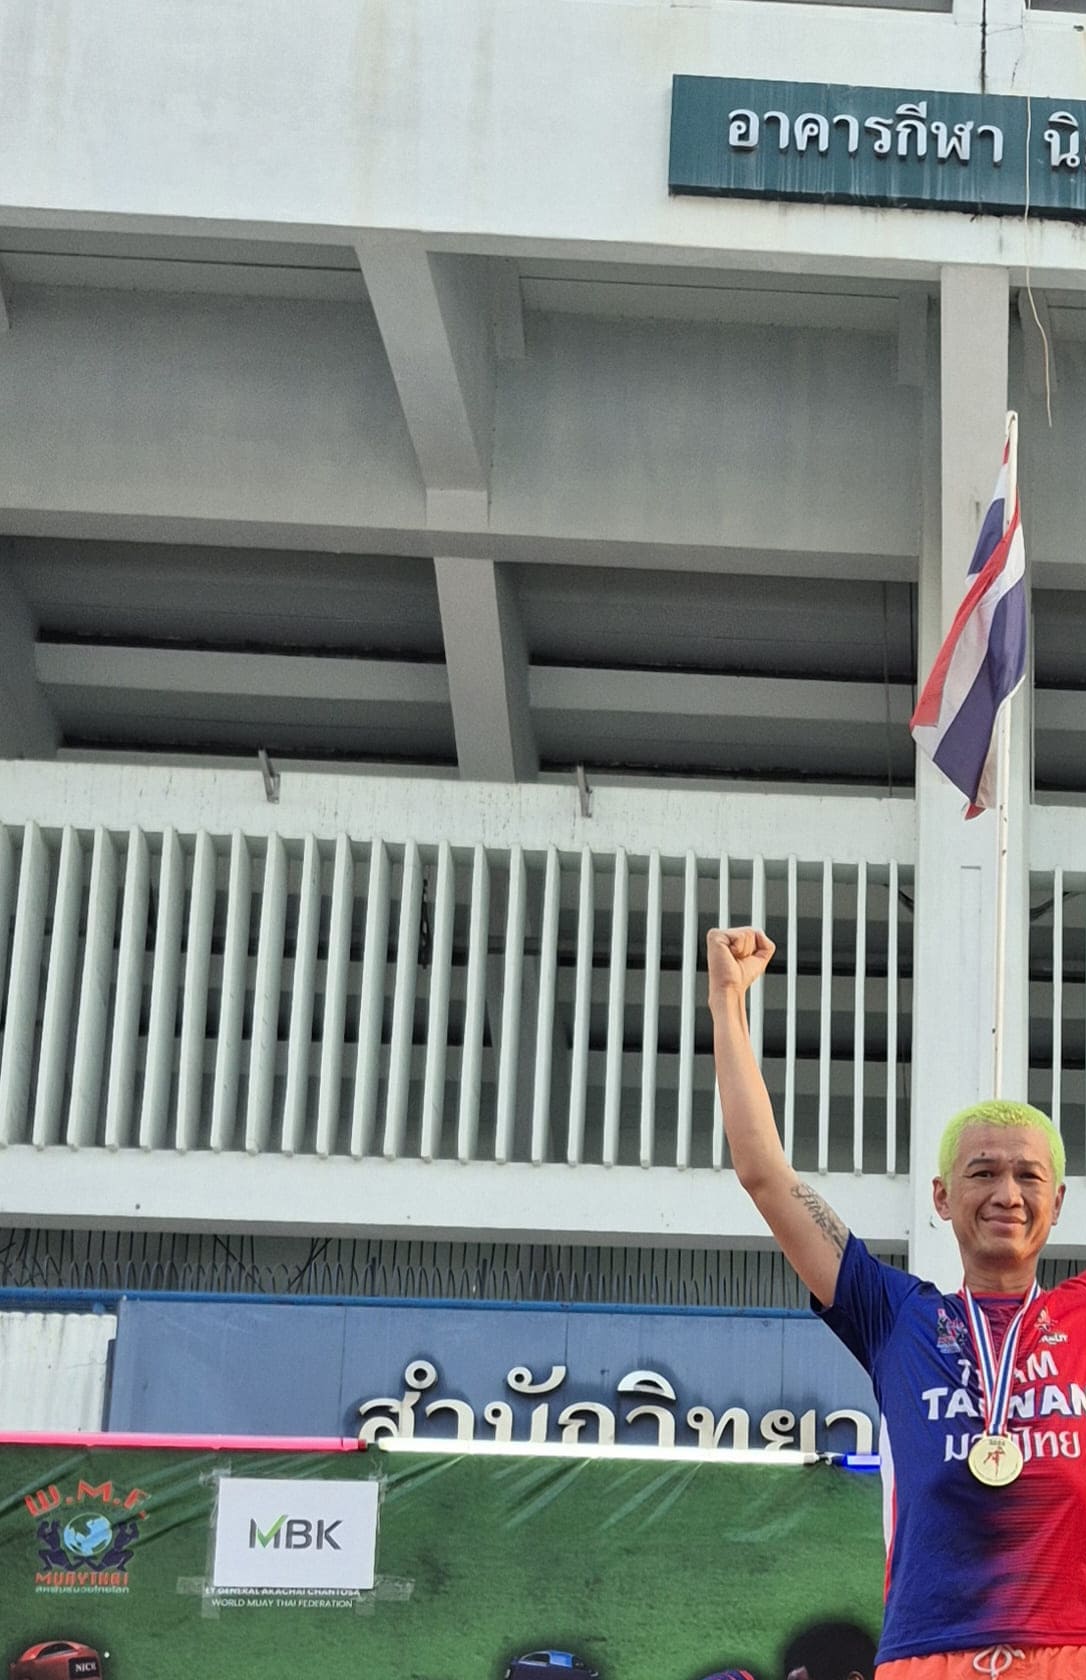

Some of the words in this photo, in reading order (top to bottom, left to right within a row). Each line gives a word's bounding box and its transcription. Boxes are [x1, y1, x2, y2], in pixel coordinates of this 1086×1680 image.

[727, 101, 1004, 164] อาคารกีฬา
[957, 1350, 1059, 1388] TM
[248, 1513, 344, 1550] MBK
[211, 1598, 245, 1607] WORLD
[247, 1598, 274, 1607] MUAY
[276, 1598, 296, 1607] THAI
[298, 1599, 354, 1608] FEDERATION
